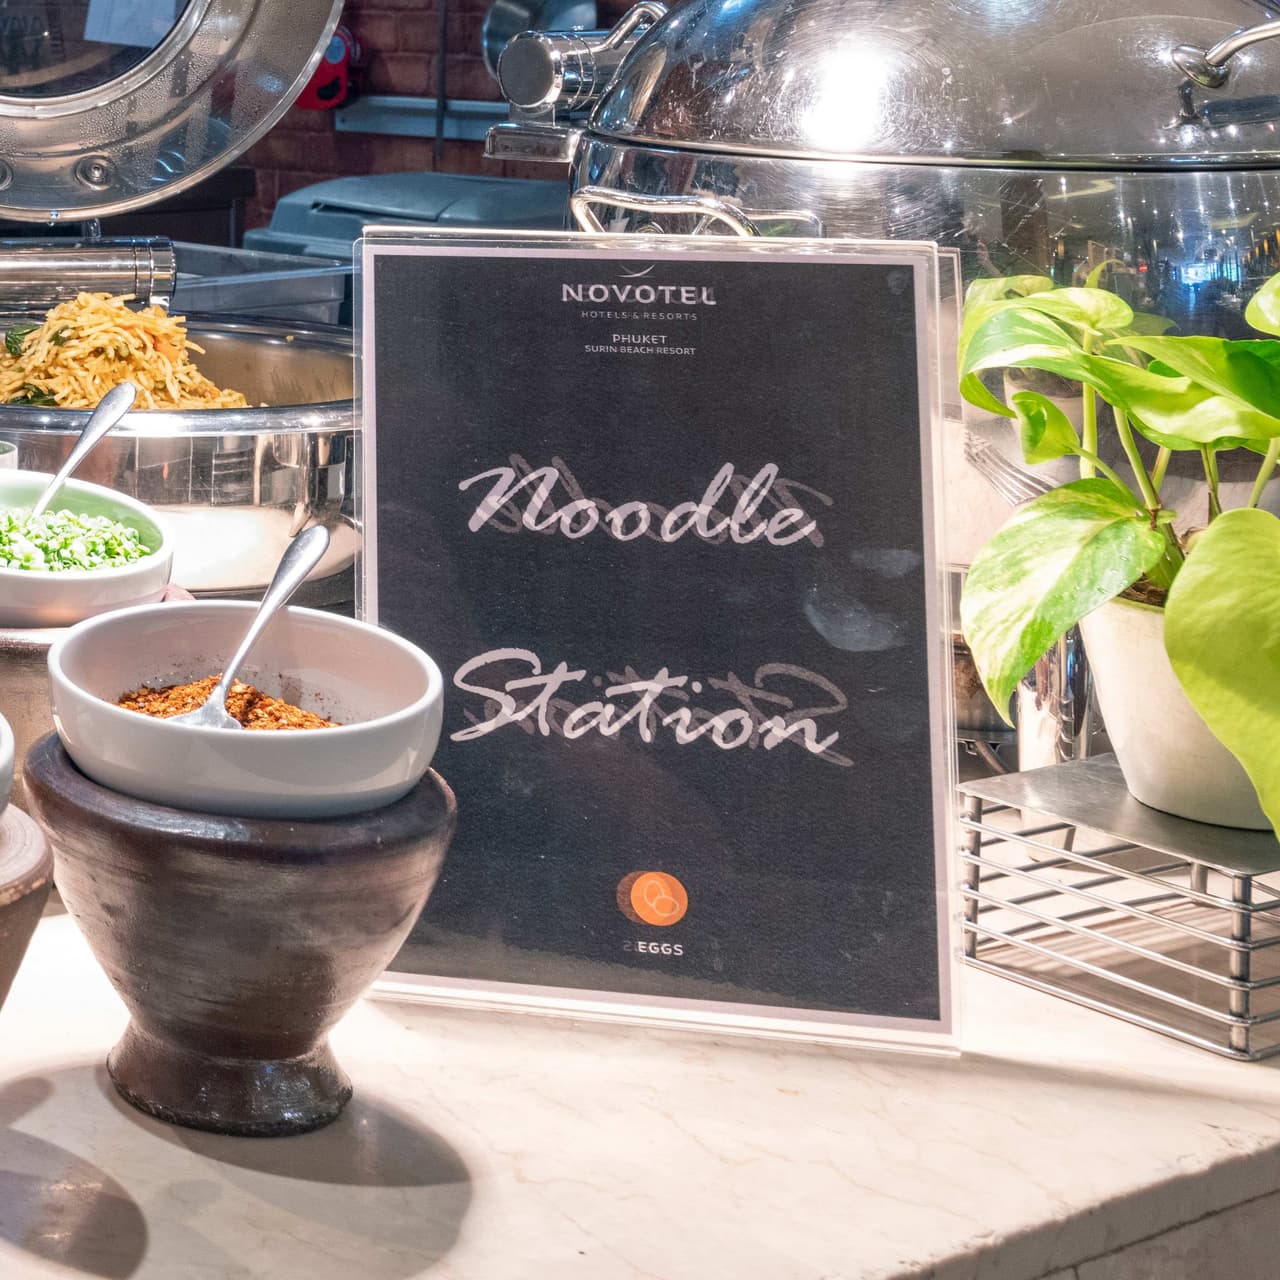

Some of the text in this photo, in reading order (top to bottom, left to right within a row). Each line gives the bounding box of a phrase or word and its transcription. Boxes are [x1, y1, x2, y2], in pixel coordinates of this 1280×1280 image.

[561, 283, 717, 306] NOVOTEL
[581, 310, 698, 321] HOTELS & RESORTS
[612, 333, 668, 345] PHUKET
[584, 344, 697, 356] SURIN BEACH RESORT
[458, 461, 818, 547] Noodle
[449, 646, 841, 755] Station
[637, 940, 684, 956] EGGS
